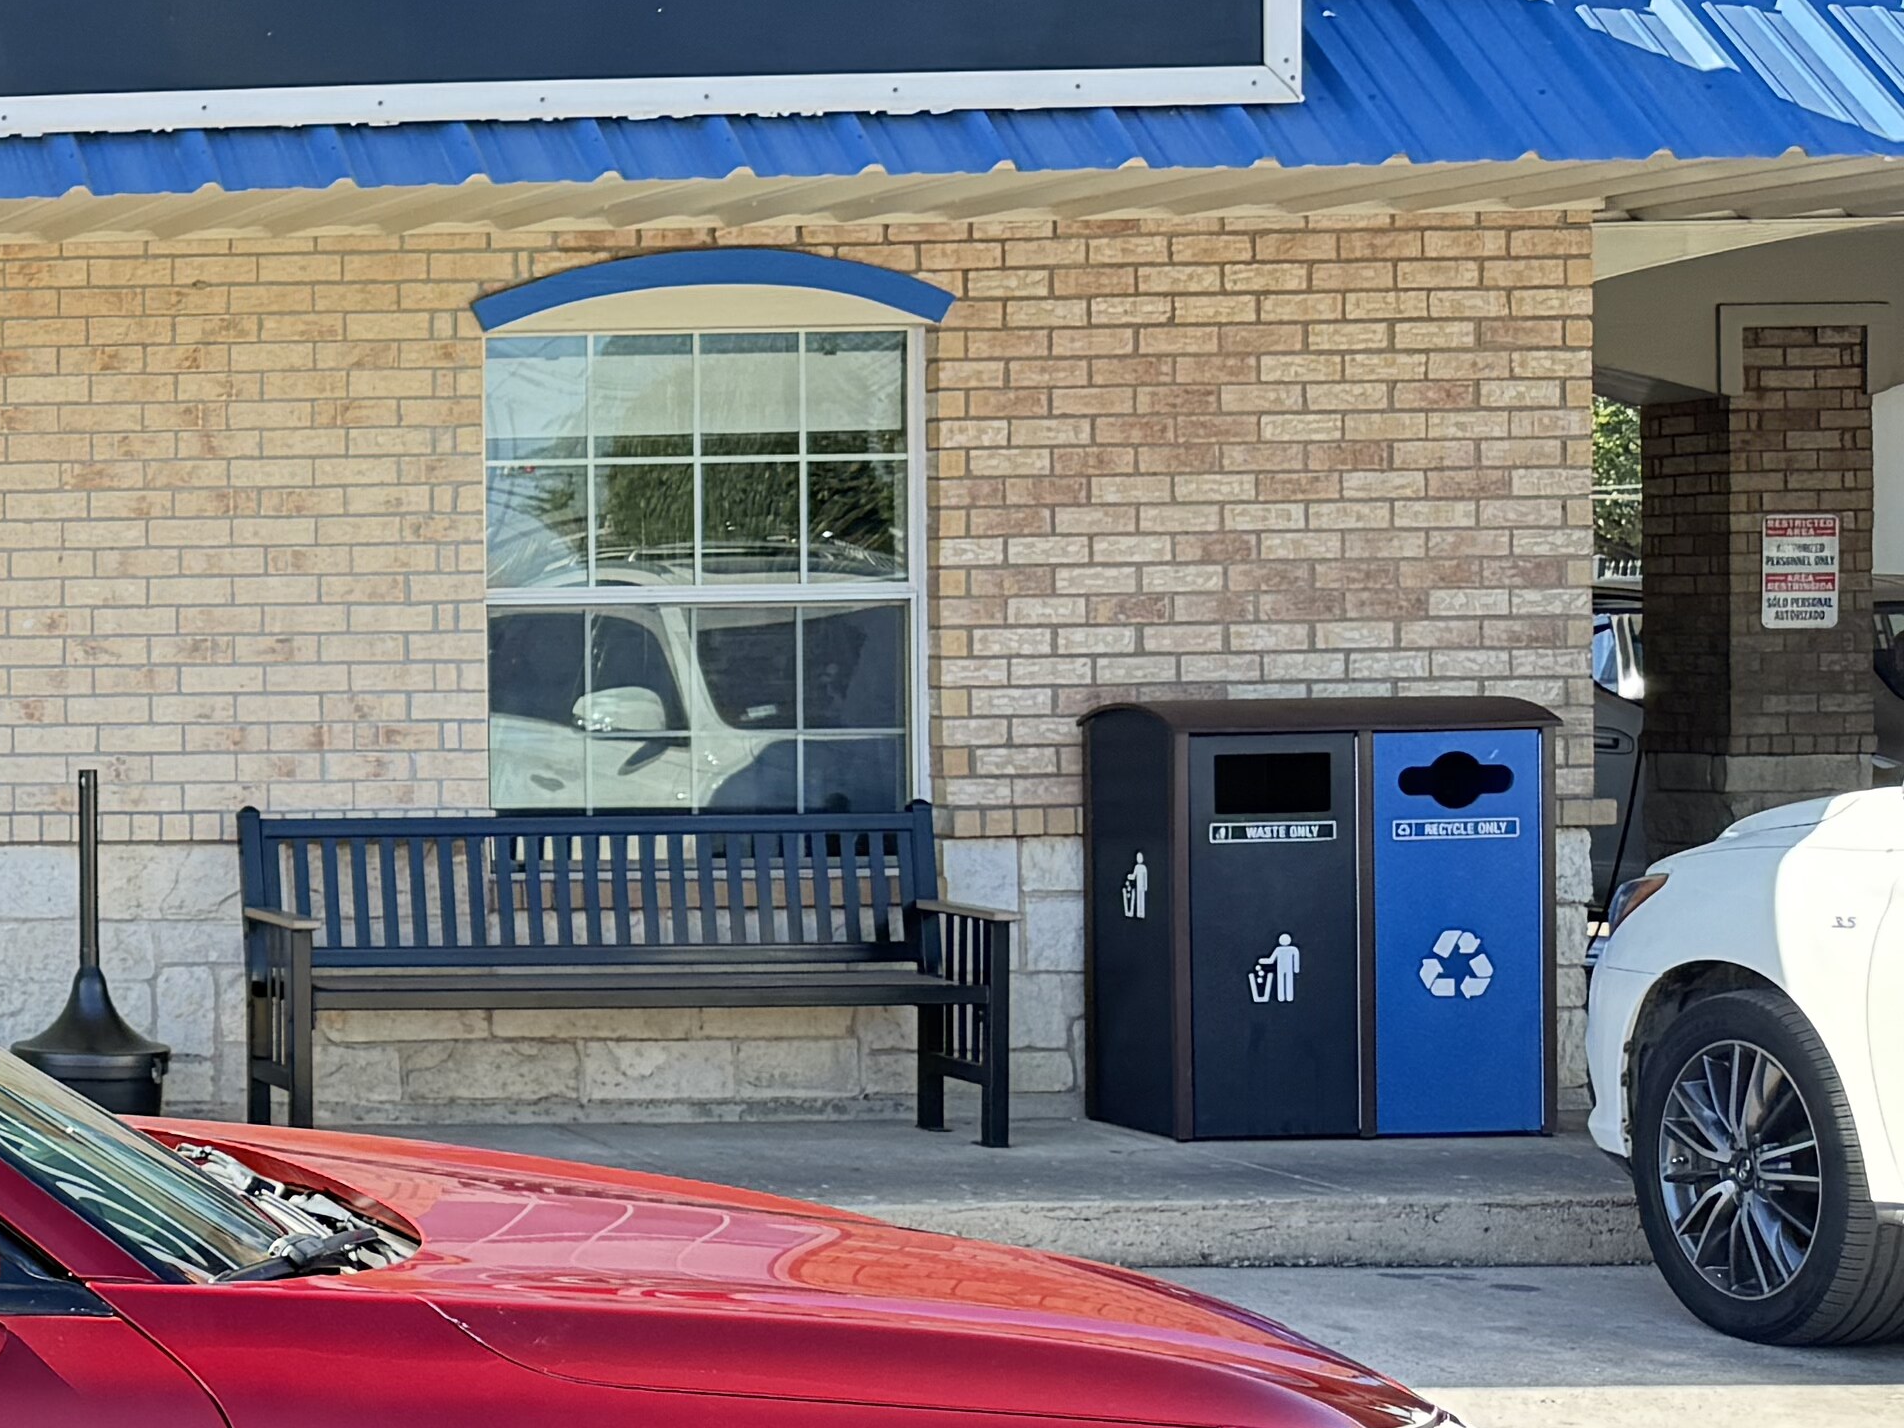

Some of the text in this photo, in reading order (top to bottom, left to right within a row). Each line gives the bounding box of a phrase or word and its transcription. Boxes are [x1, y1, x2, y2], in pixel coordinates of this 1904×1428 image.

[1766, 519, 1834, 528] RESTRICTED
[1786, 528, 1815, 536] AREA
[1765, 555, 1835, 566] PERSONNEL ONLY
[1790, 597, 1833, 608] PERSONAL
[1774, 610, 1825, 620] AUTORIZADO
[1245, 824, 1319, 839] WASTE ONLY
[1424, 821, 1507, 835] RECYCLE ONLY
